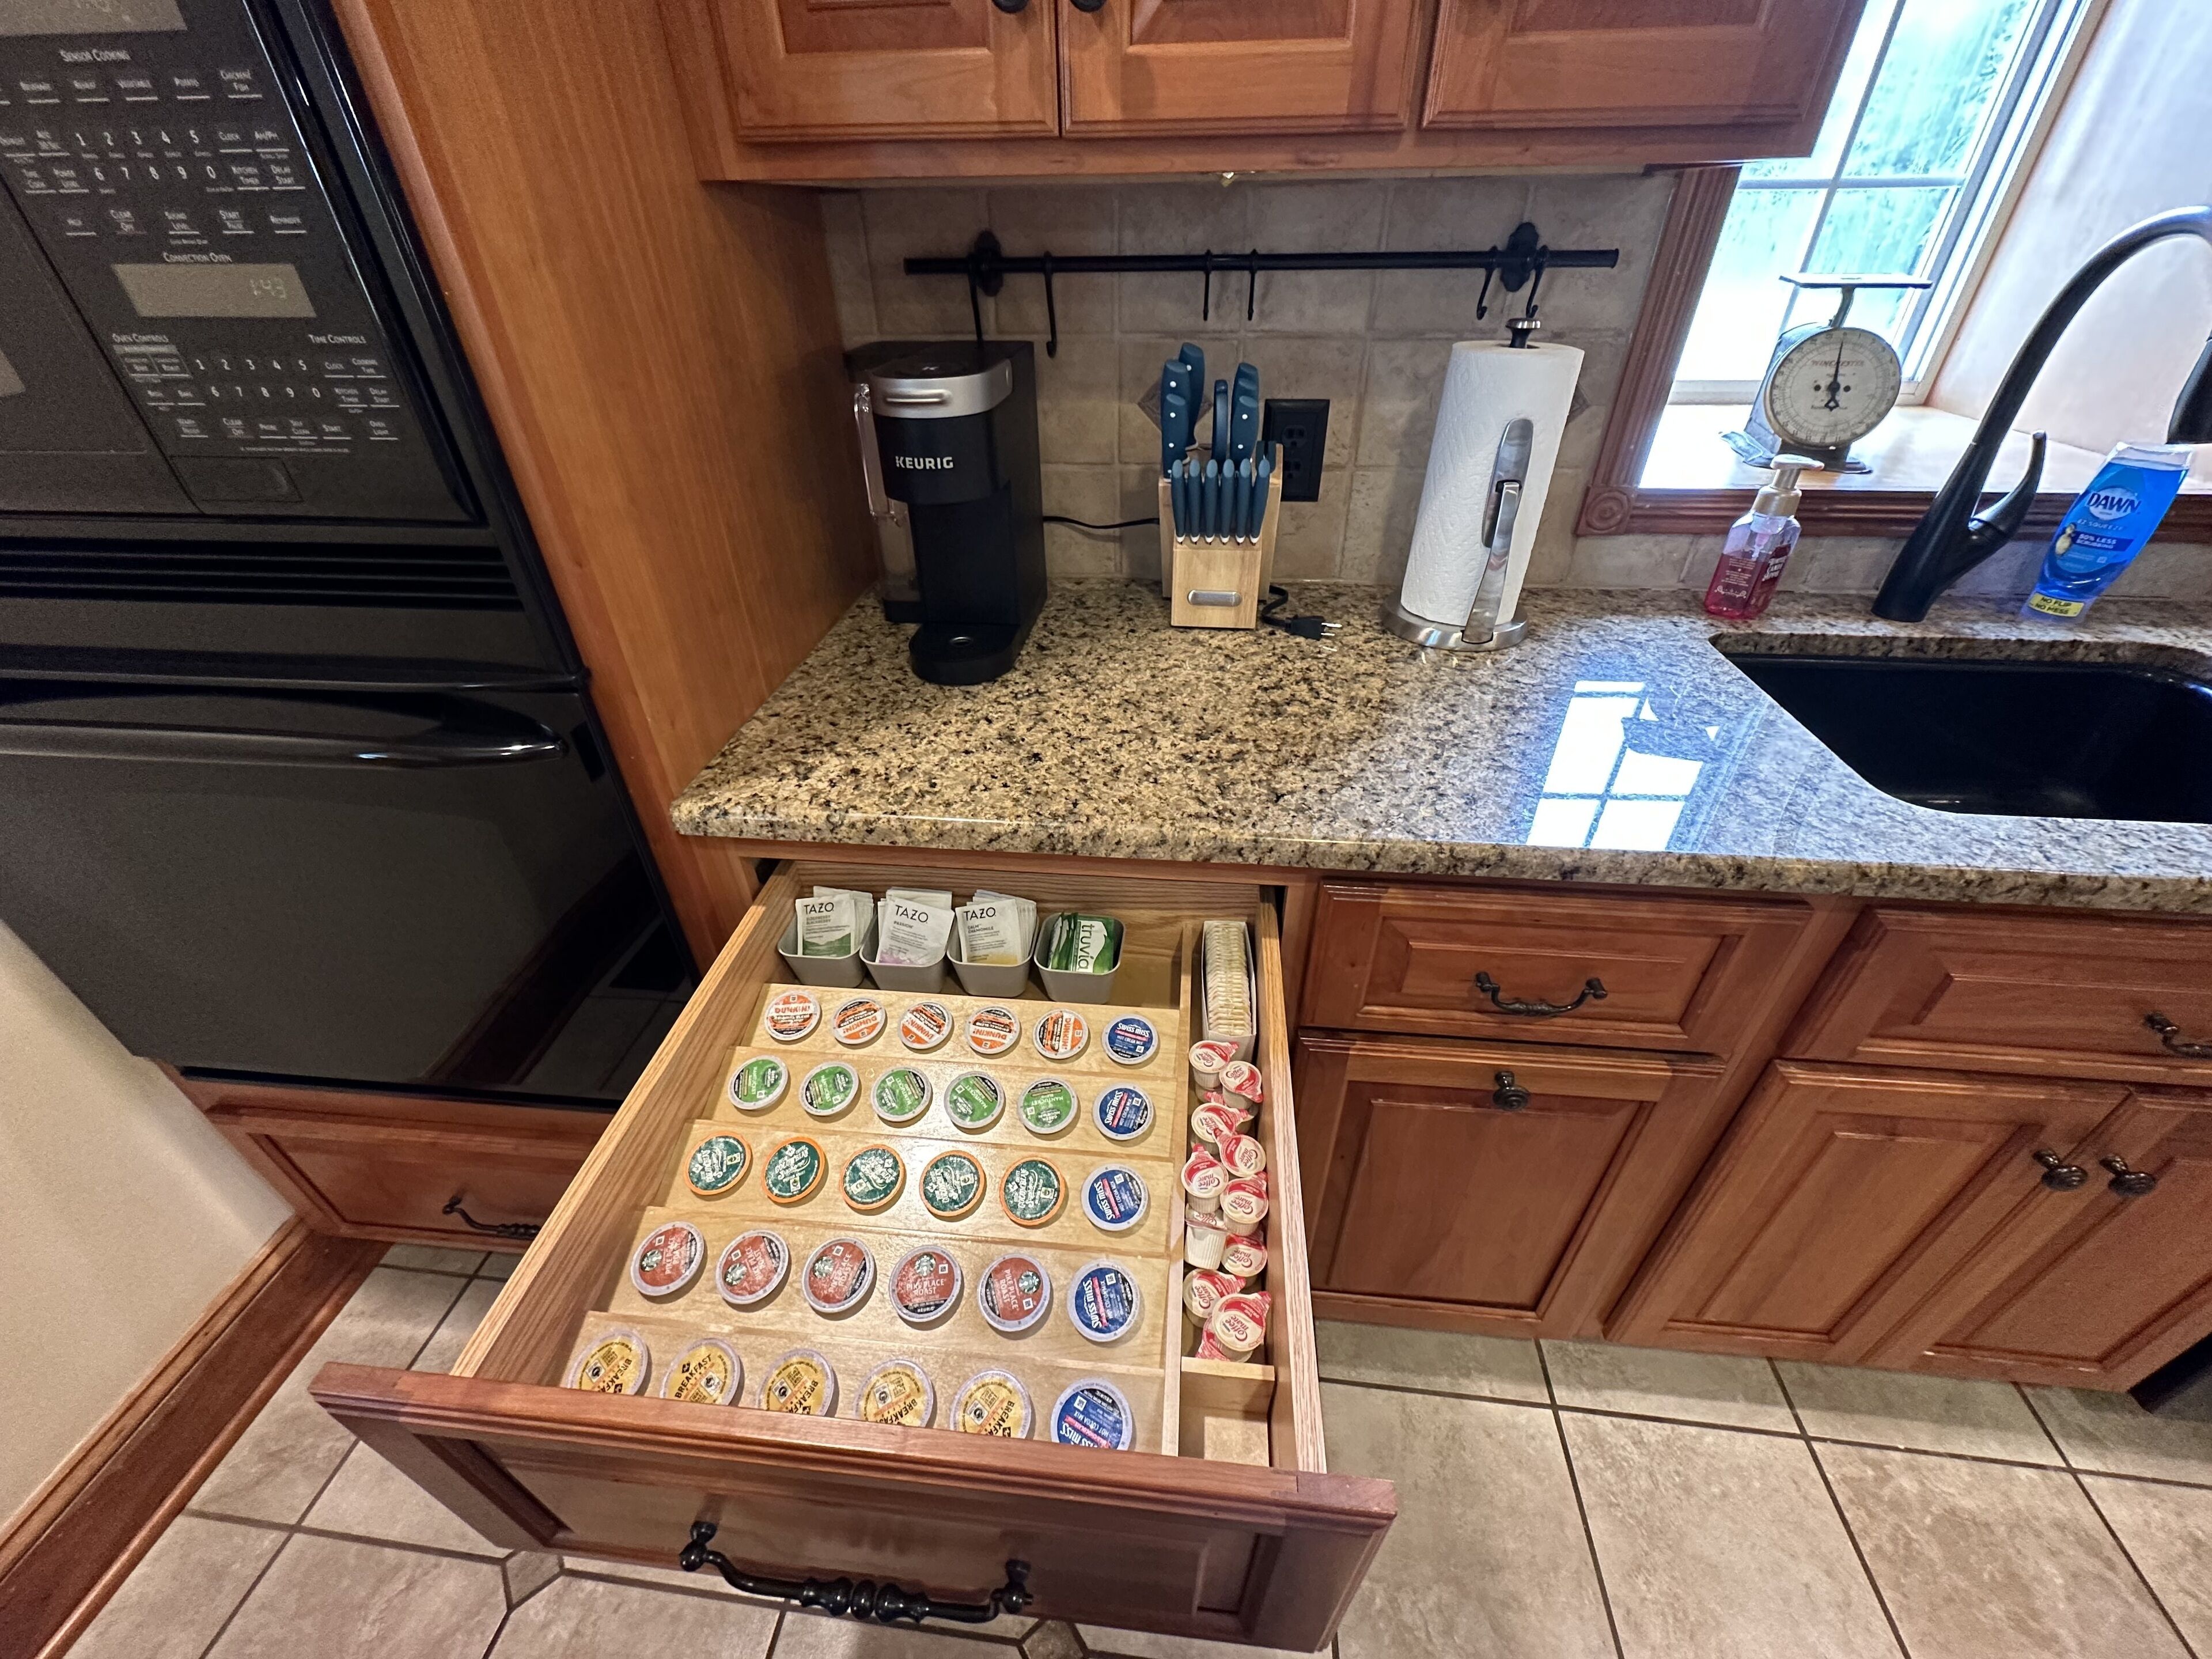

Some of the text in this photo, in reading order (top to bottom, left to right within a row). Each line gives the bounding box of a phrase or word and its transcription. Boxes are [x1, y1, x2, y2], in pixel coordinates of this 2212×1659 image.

[75, 133, 86, 146] 1
[103, 132, 114, 146] 2
[131, 131, 142, 145] 3
[161, 131, 171, 144] 4
[189, 130, 199, 143] 5
[94, 168, 104, 181] 6
[121, 167, 130, 180] 7
[149, 166, 160, 180] 8
[177, 166, 187, 179] 9
[207, 166, 216, 179] 0
[308, 334, 367, 344] TIME CONTROLS
[195, 359, 205, 370] 1
[221, 359, 231, 370] 2
[246, 359, 255, 370] 3
[273, 359, 282, 370] 4
[298, 359, 307, 371] 5
[210, 386, 220, 397] 6
[235, 387, 243, 397] 7
[261, 387, 270, 398] 8
[286, 387, 294, 398] 9
[312, 387, 321, 398] 0
[895, 456, 954, 469] KEURIG
[2086, 493, 2142, 513] DAWN
[2075, 539, 2114, 550] SCRUBBING
[2078, 533, 2118, 545] 50% LESS
[2054, 599, 2072, 608] FLIP
[2047, 607, 2070, 615] MESS
[804, 902, 835, 914] TAZO
[895, 904, 929, 923] TAZO
[963, 907, 997, 921] TAZO
[1116, 1022, 1136, 1034] SWISS
[1135, 1027, 1150, 1037] MISS
[1225, 1067, 1243, 1078] Coffee
[1031, 1096, 1064, 1106] NANTUCKET
[1104, 1105, 1118, 1126] SWISS
[1112, 1090, 1124, 1108] MISS
[1243, 1149, 1258, 1167] Coffee
[1198, 1173, 1214, 1182] mate
[1198, 1176, 1221, 1188] Coffee
[1094, 1181, 1107, 1202] MISS
[1230, 1199, 1253, 1215] Coffee
[1234, 1195, 1253, 1206] mate
[1101, 1196, 1116, 1221] SWISS
[1229, 1251, 1253, 1268] Coffee
[999, 1278, 1012, 1304] ROAST
[1003, 1268, 1019, 1310] PIKE PLACE
[1082, 1277, 1094, 1303] MISS
[1200, 1283, 1215, 1302] mate
[1194, 1285, 1211, 1309] Coffee
[1088, 1304, 1103, 1329] SWISS
[1230, 1314, 1249, 1331] mate
[1225, 1318, 1248, 1342] Coffee
[600, 1358, 632, 1393] BREAKFA
[675, 1354, 713, 1399] BREAKFAST
[788, 1380, 819, 1414] BREAKFA
[879, 1398, 918, 1425] BREAKFAS
[987, 1400, 1015, 1436] BREAKFA
[1059, 1422, 1081, 1445] MISS
